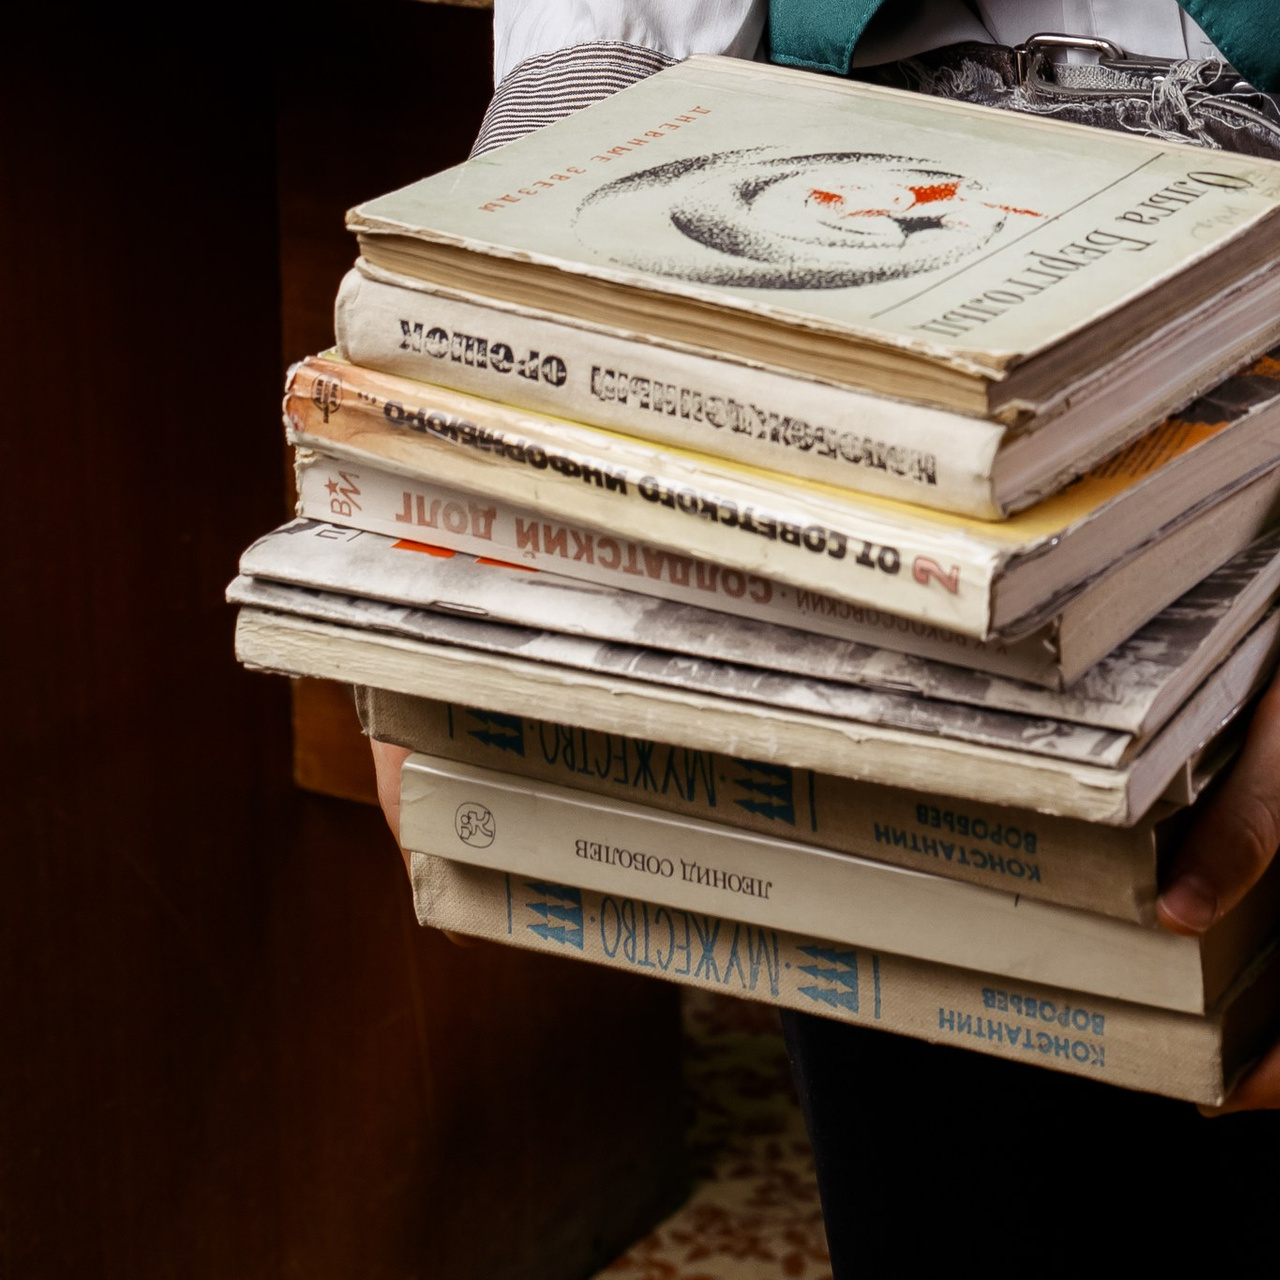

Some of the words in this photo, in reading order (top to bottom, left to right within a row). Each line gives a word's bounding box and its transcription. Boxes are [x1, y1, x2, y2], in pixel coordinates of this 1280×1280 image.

[589, 105, 712, 164] ДНЕВНЫЕ
[478, 165, 587, 215] ЗВЕЗДЫ
[1114, 169, 1256, 226] Ольга
[396, 491, 497, 543] ДОЛГ
[638, 474, 850, 561] СОВЕТСКОГО
[514, 515, 774, 606] СОЛДАТСКИЙ
[855, 541, 902, 576] ОТ
[539, 720, 718, 808] МУЖЕСТВО
[875, 822, 1043, 884] КОНСТАНТИН
[916, 802, 1038, 854] ВОРОБЬЕВ
[574, 837, 675, 881] СОБОЛЕВ
[679, 854, 774, 900] ЛЕОНИД
[600, 896, 782, 997] МУЖЕСТВО
[938, 1006, 1107, 1068] КОНСТАНТИН
[981, 986, 1106, 1036] ВОРОБЬЕВ
